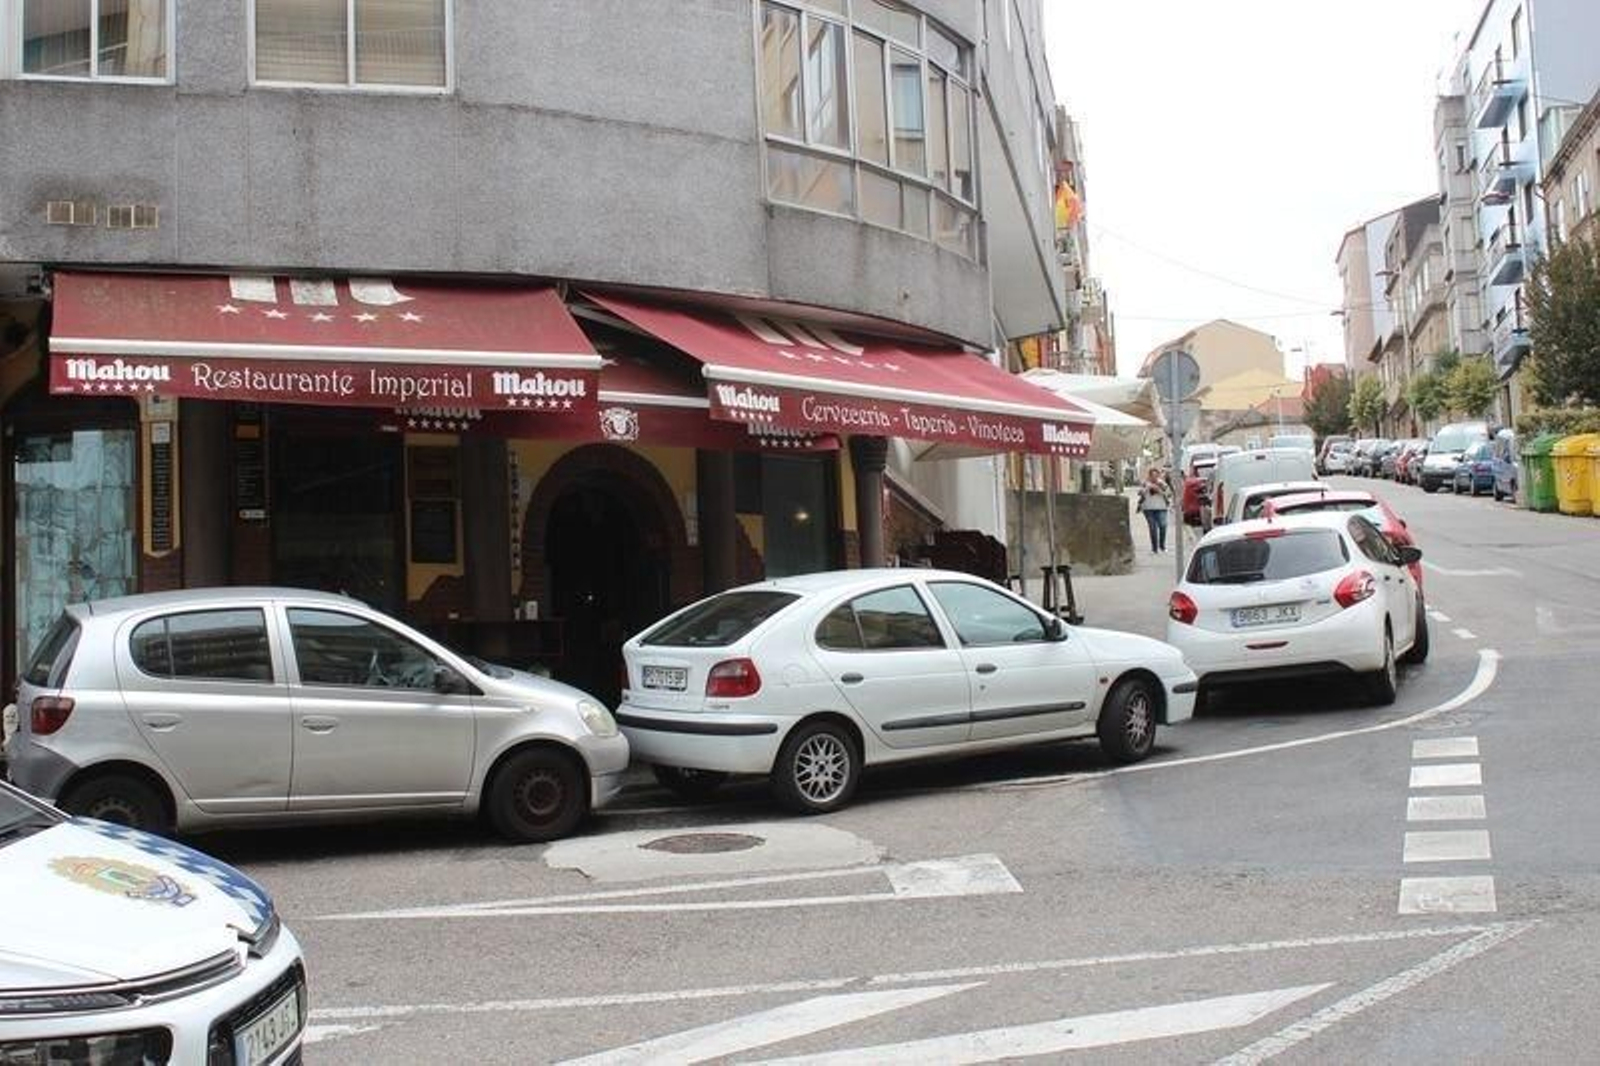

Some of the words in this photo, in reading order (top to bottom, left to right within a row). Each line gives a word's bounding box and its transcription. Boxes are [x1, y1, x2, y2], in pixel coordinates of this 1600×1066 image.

[66, 358, 171, 381] Mahou
[191, 363, 355, 396] Restaurante
[370, 369, 473, 402] Imperial
[493, 371, 587, 397] Mahou
[716, 384, 781, 412] Mahou
[967, 415, 1025, 443] Vinoteca
[1042, 423, 1091, 446] Mahou
